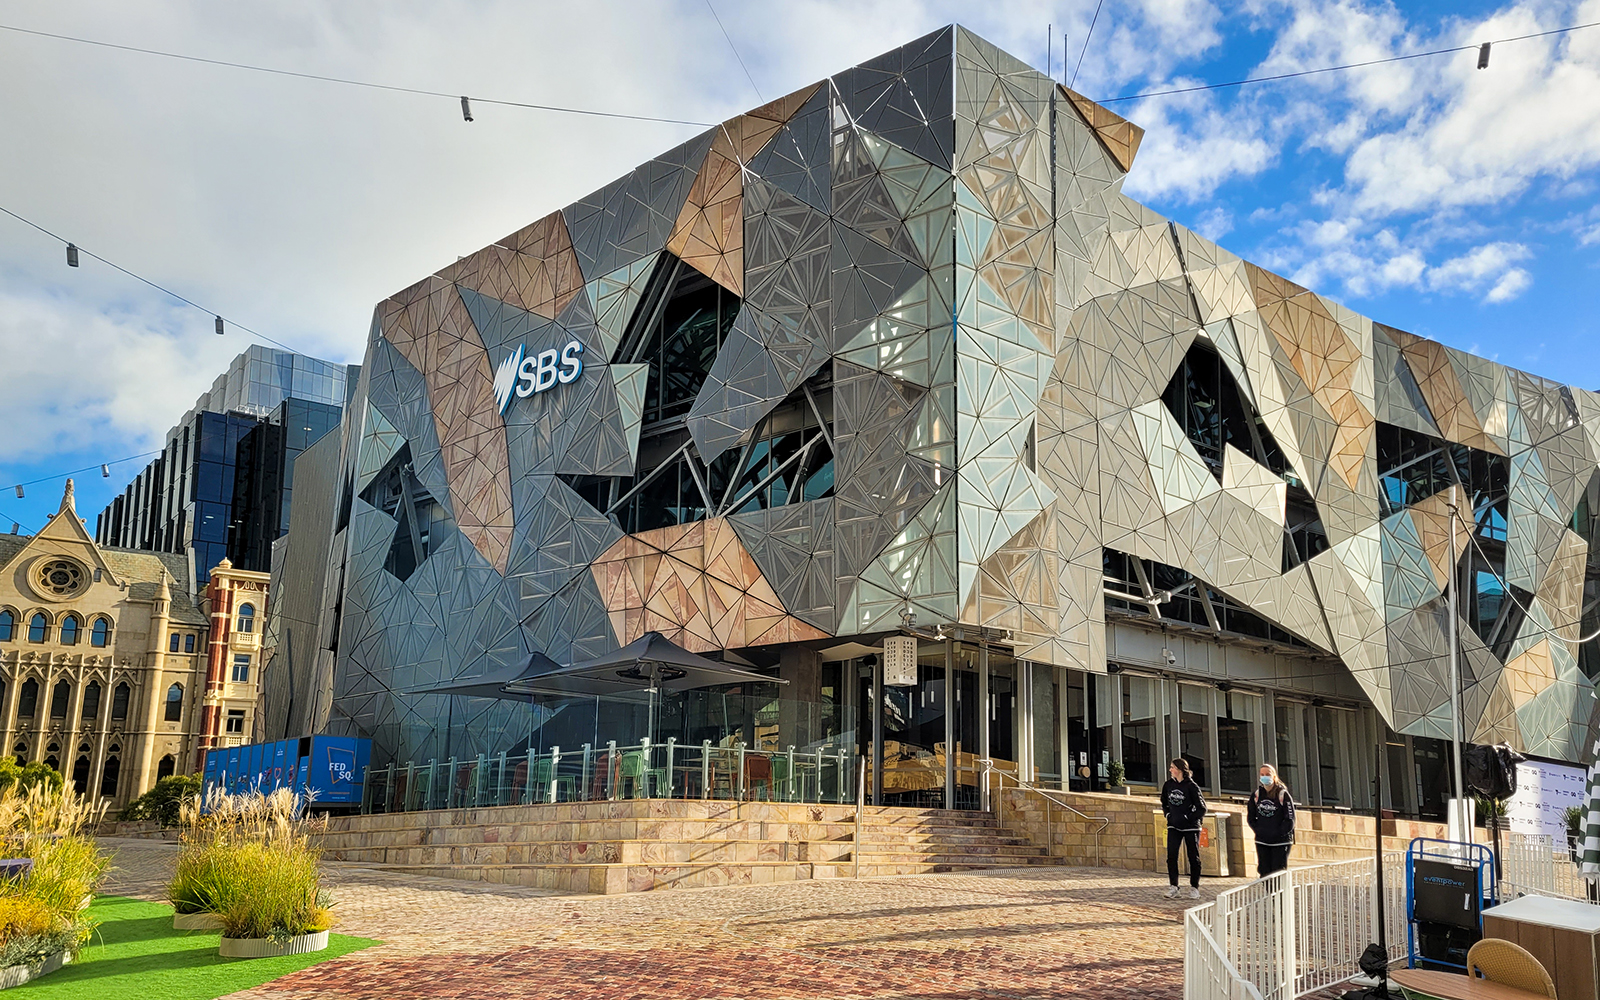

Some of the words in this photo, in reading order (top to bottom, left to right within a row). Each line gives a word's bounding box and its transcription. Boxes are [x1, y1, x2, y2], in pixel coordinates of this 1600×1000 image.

[516, 341, 583, 398] SBS
[329, 762, 346, 771] FED
[338, 771, 353, 781] SQ.
[1423, 876, 1466, 887] eventpower
